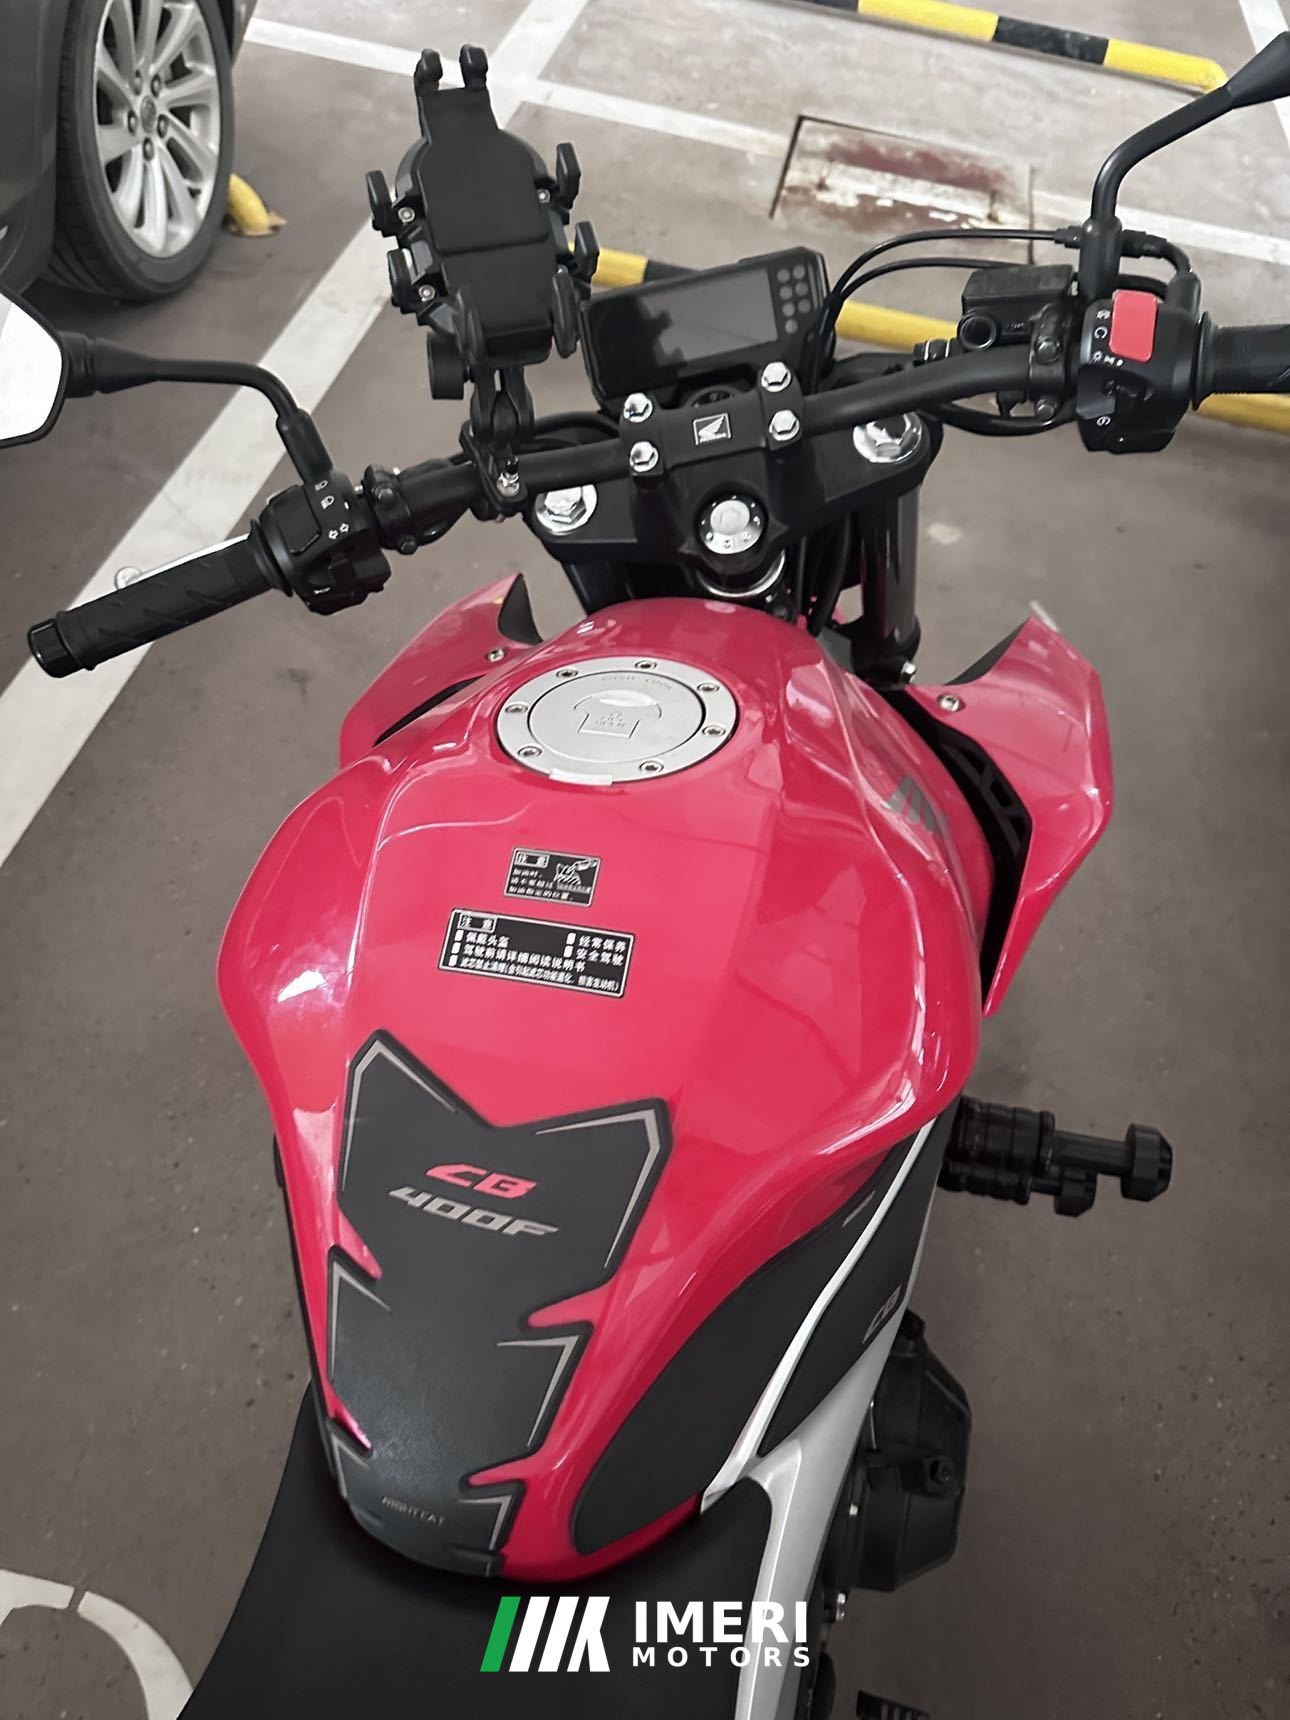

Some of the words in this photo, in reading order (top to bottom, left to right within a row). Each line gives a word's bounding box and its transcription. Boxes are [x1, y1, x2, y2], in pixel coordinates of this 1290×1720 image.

[461, 915, 492, 930] 注意
[466, 931, 510, 948] 佩戴头盔
[579, 935, 627, 953] 经常保养
[463, 944, 586, 973] 驾驶前请详细阅读说明书
[576, 948, 624, 966] 安全驾驶
[426, 1163, 537, 1199] CB
[389, 1186, 560, 1236] 400F
